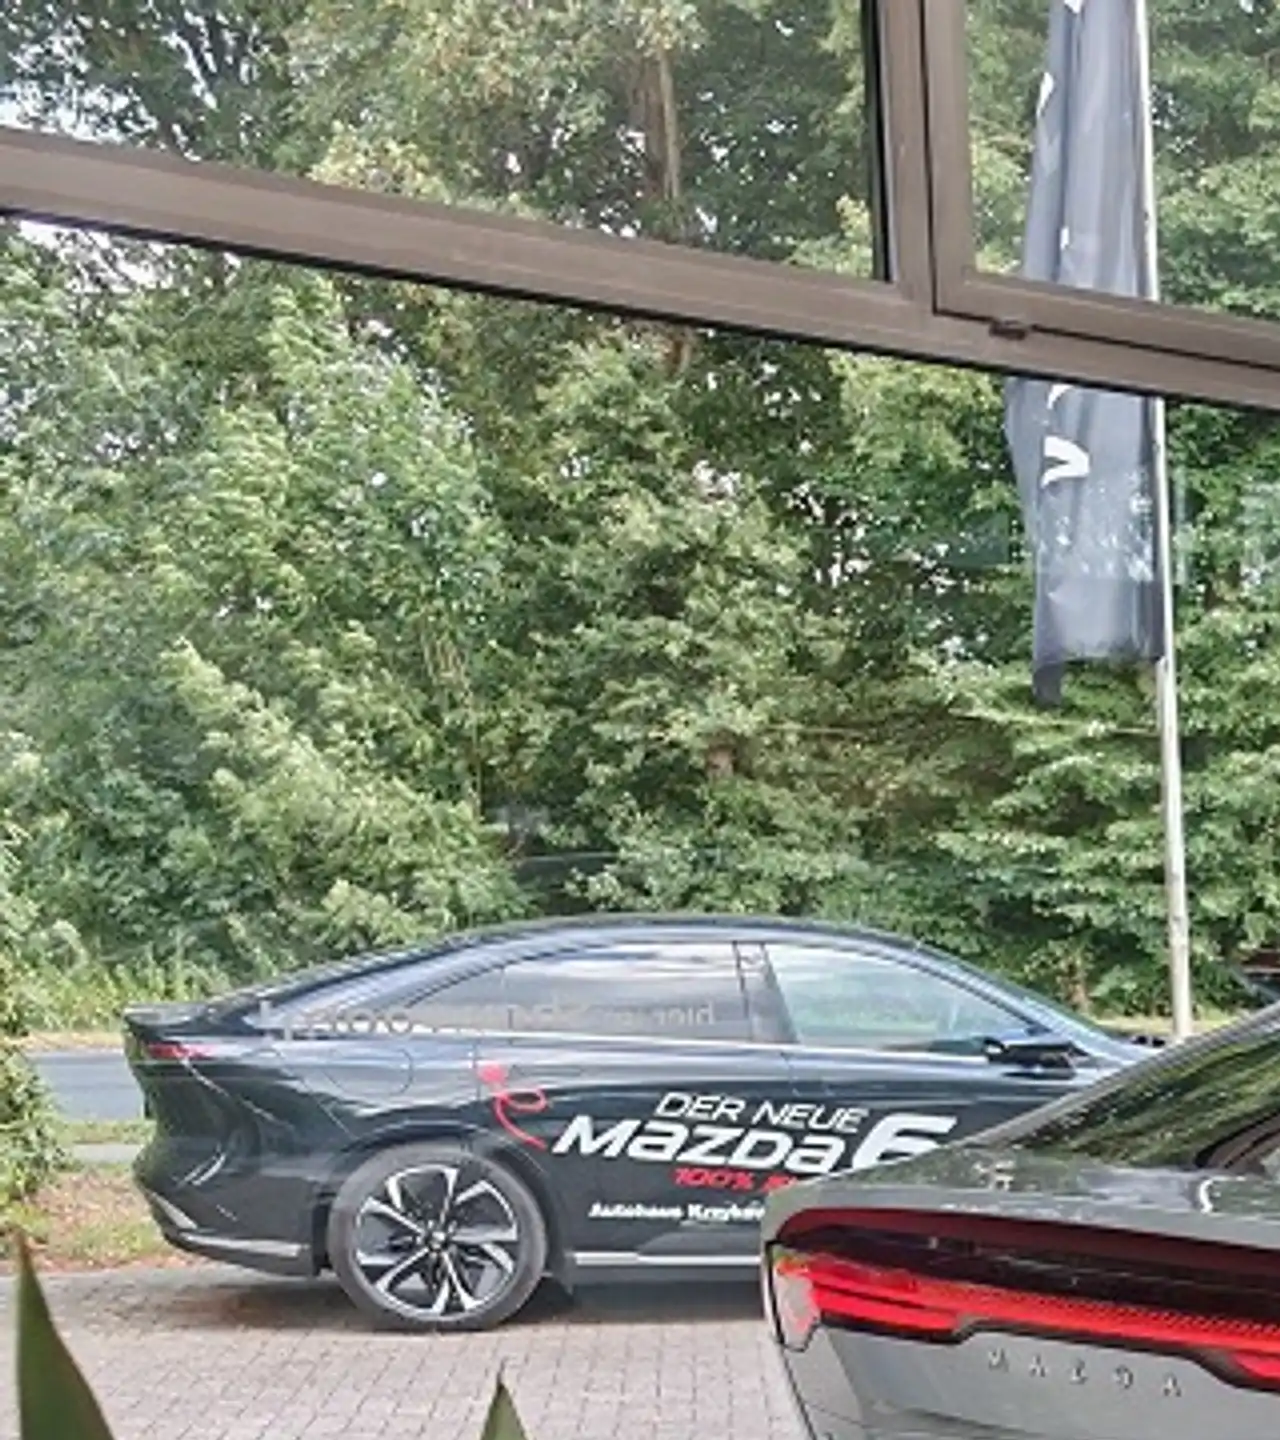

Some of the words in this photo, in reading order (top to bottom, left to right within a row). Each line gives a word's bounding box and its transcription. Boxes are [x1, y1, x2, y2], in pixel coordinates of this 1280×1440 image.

[655, 1091, 747, 1123] DER
[751, 1101, 869, 1133] NEUE
[988, 1348, 1182, 1398] MAZDA
